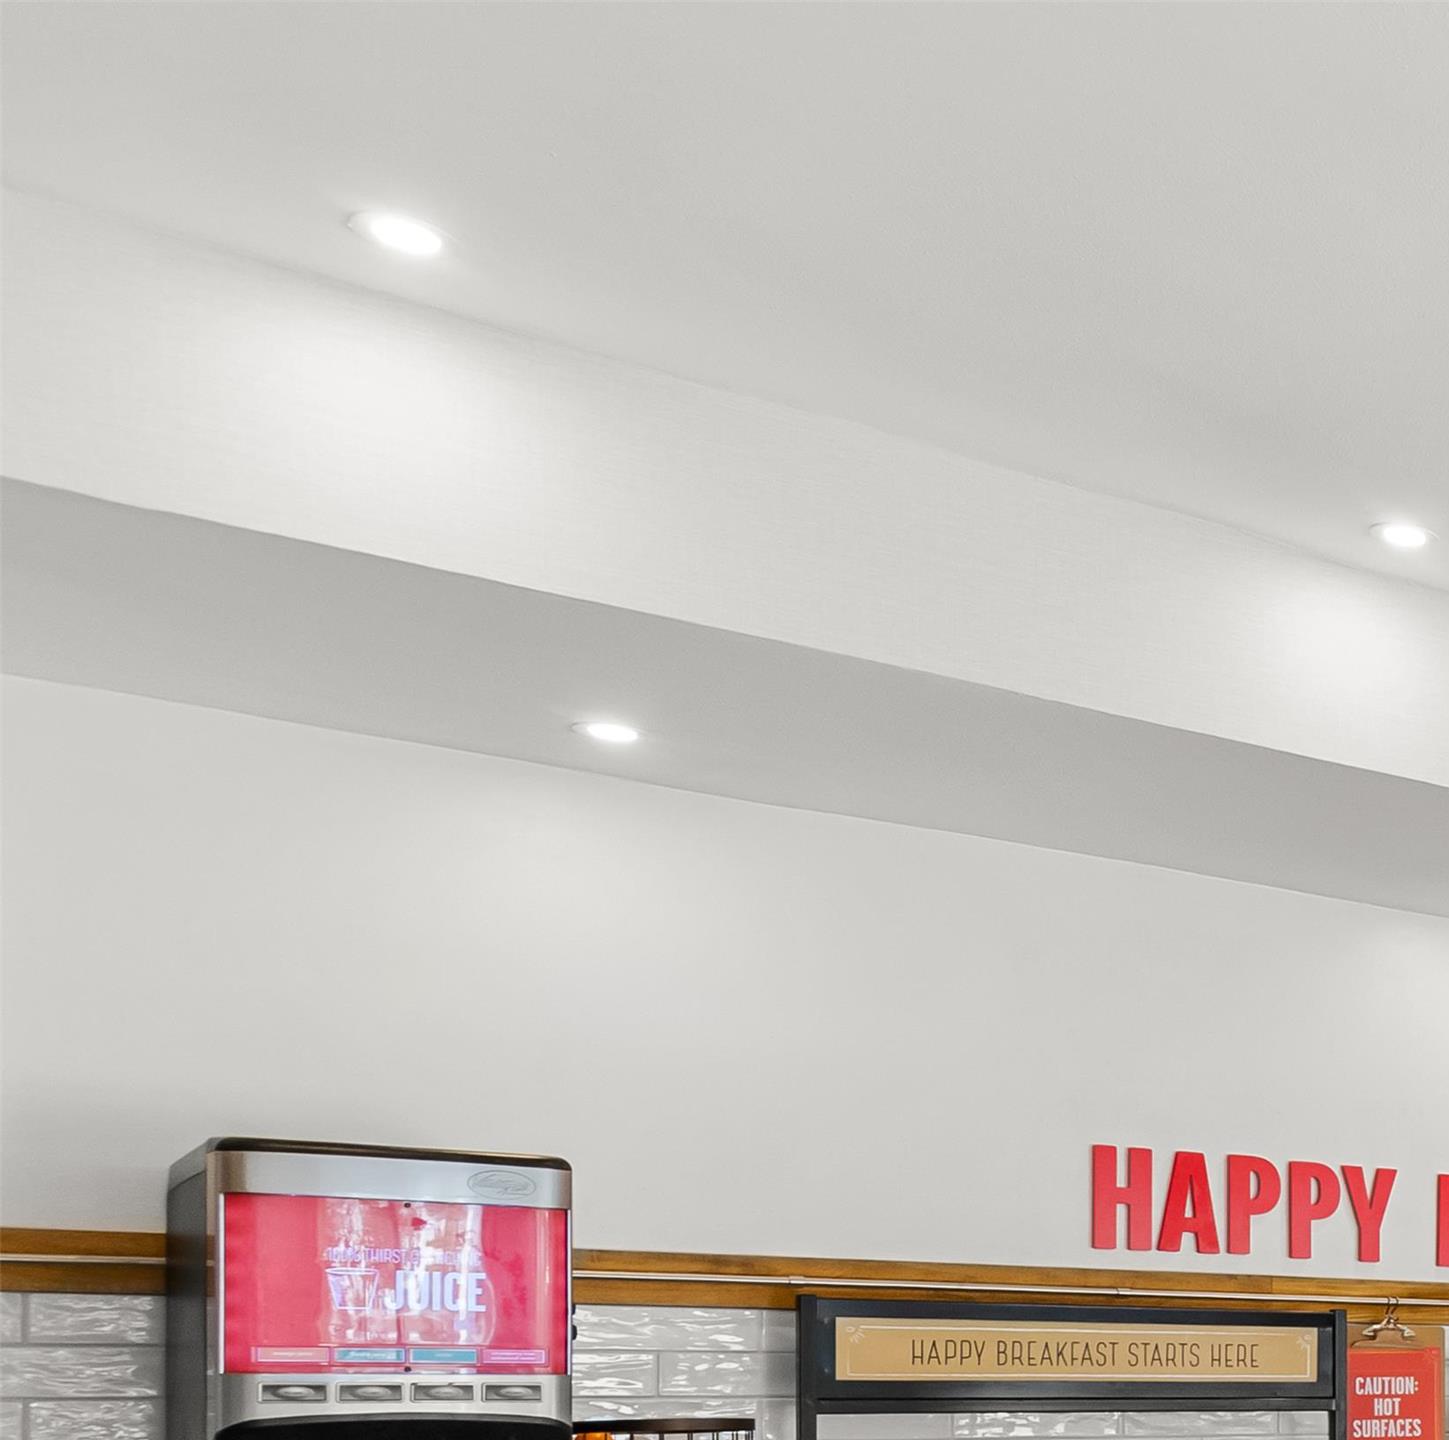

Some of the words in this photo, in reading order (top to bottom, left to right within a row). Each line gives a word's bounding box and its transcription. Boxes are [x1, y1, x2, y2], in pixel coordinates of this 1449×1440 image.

[1091, 1144, 1397, 1263] HAPPY
[364, 1248, 408, 1264] THIRST
[384, 1270, 487, 1312] JUICE
[911, 1339, 987, 1366] HAPPY
[996, 1340, 1119, 1367] BREAKFAST
[1127, 1343, 1200, 1367] STARTS
[1210, 1344, 1260, 1368] HERE
[1355, 1376, 1419, 1395] CAUTION:
[1374, 1398, 1401, 1416] HOT
[1352, 1418, 1422, 1438] SURFACES
